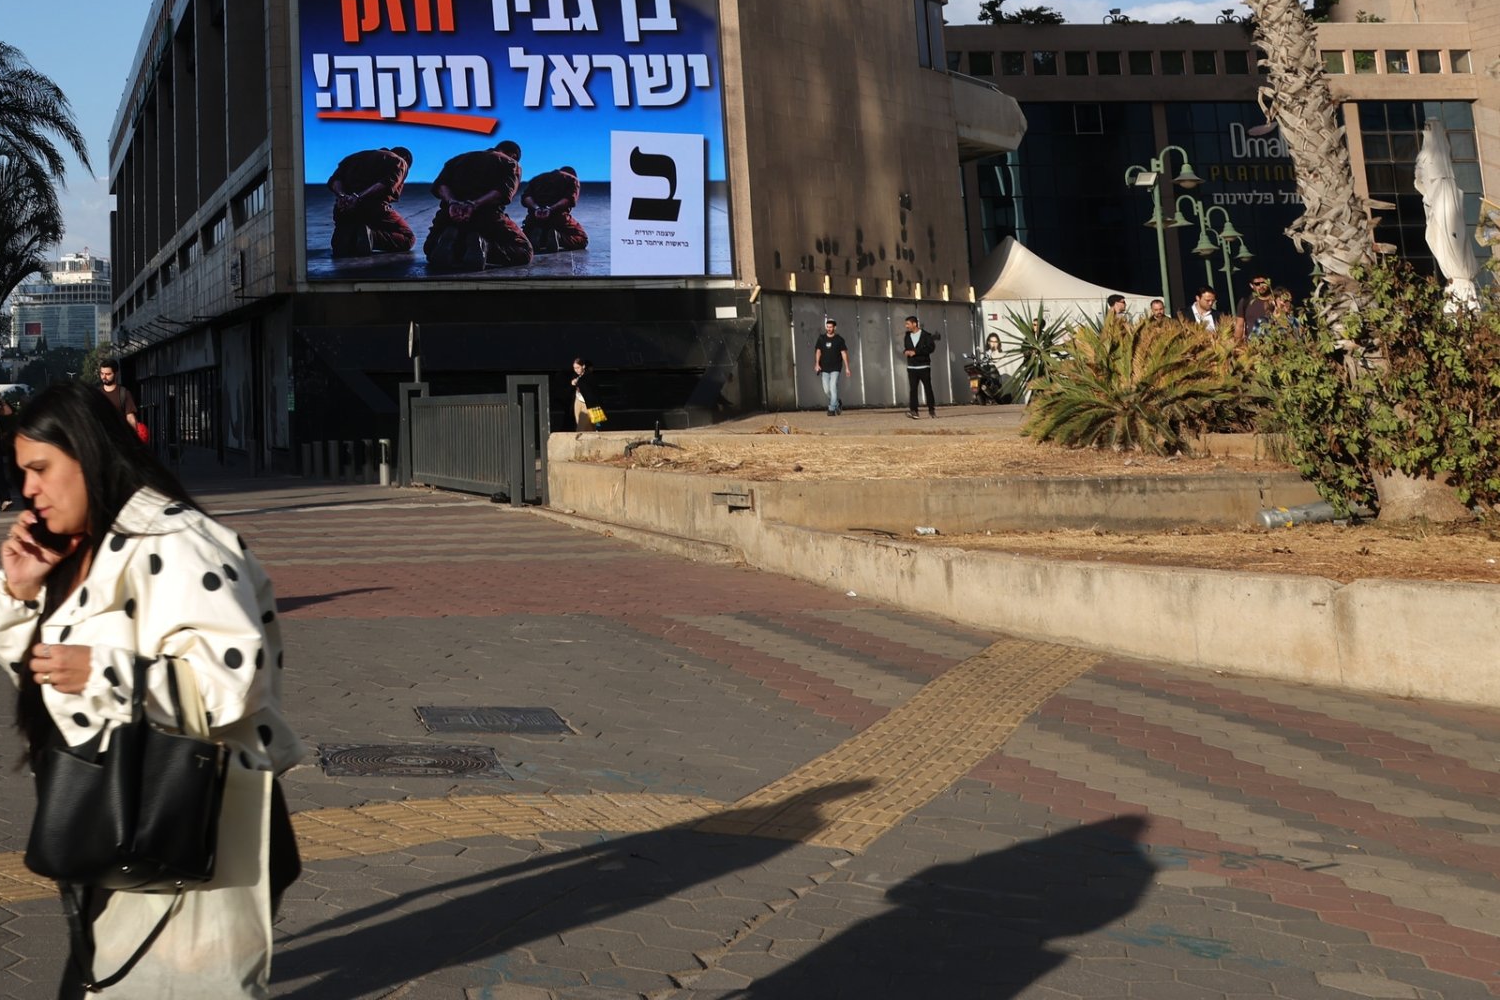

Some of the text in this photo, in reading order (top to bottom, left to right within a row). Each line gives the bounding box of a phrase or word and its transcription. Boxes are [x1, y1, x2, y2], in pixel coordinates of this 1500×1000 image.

[313, 46, 710, 118] ישראל חזקה!
[627, 146, 682, 222] ב
[1212, 189, 1274, 204] פלטינום
